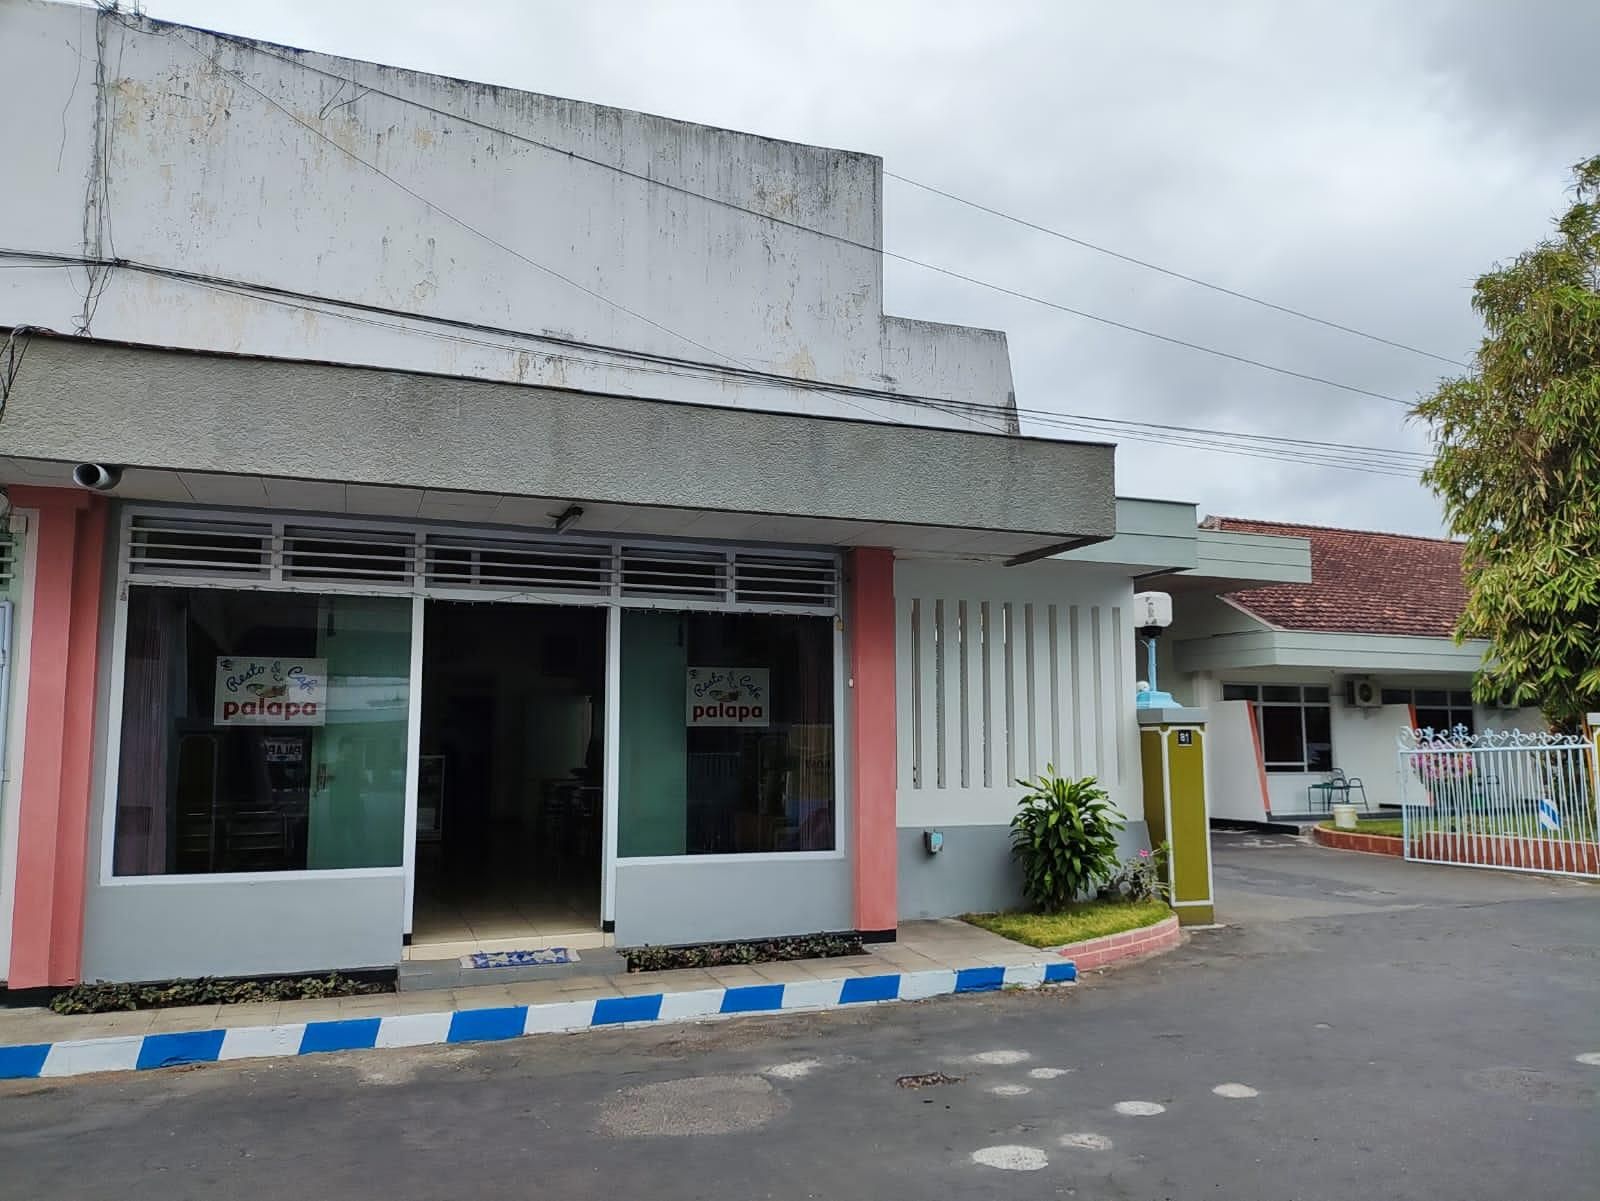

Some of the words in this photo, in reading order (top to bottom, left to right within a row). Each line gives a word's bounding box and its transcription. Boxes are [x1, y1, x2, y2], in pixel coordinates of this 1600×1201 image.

[226, 662, 264, 693] Resto
[223, 698, 317, 720] palapa
[693, 703, 762, 722] palapa
